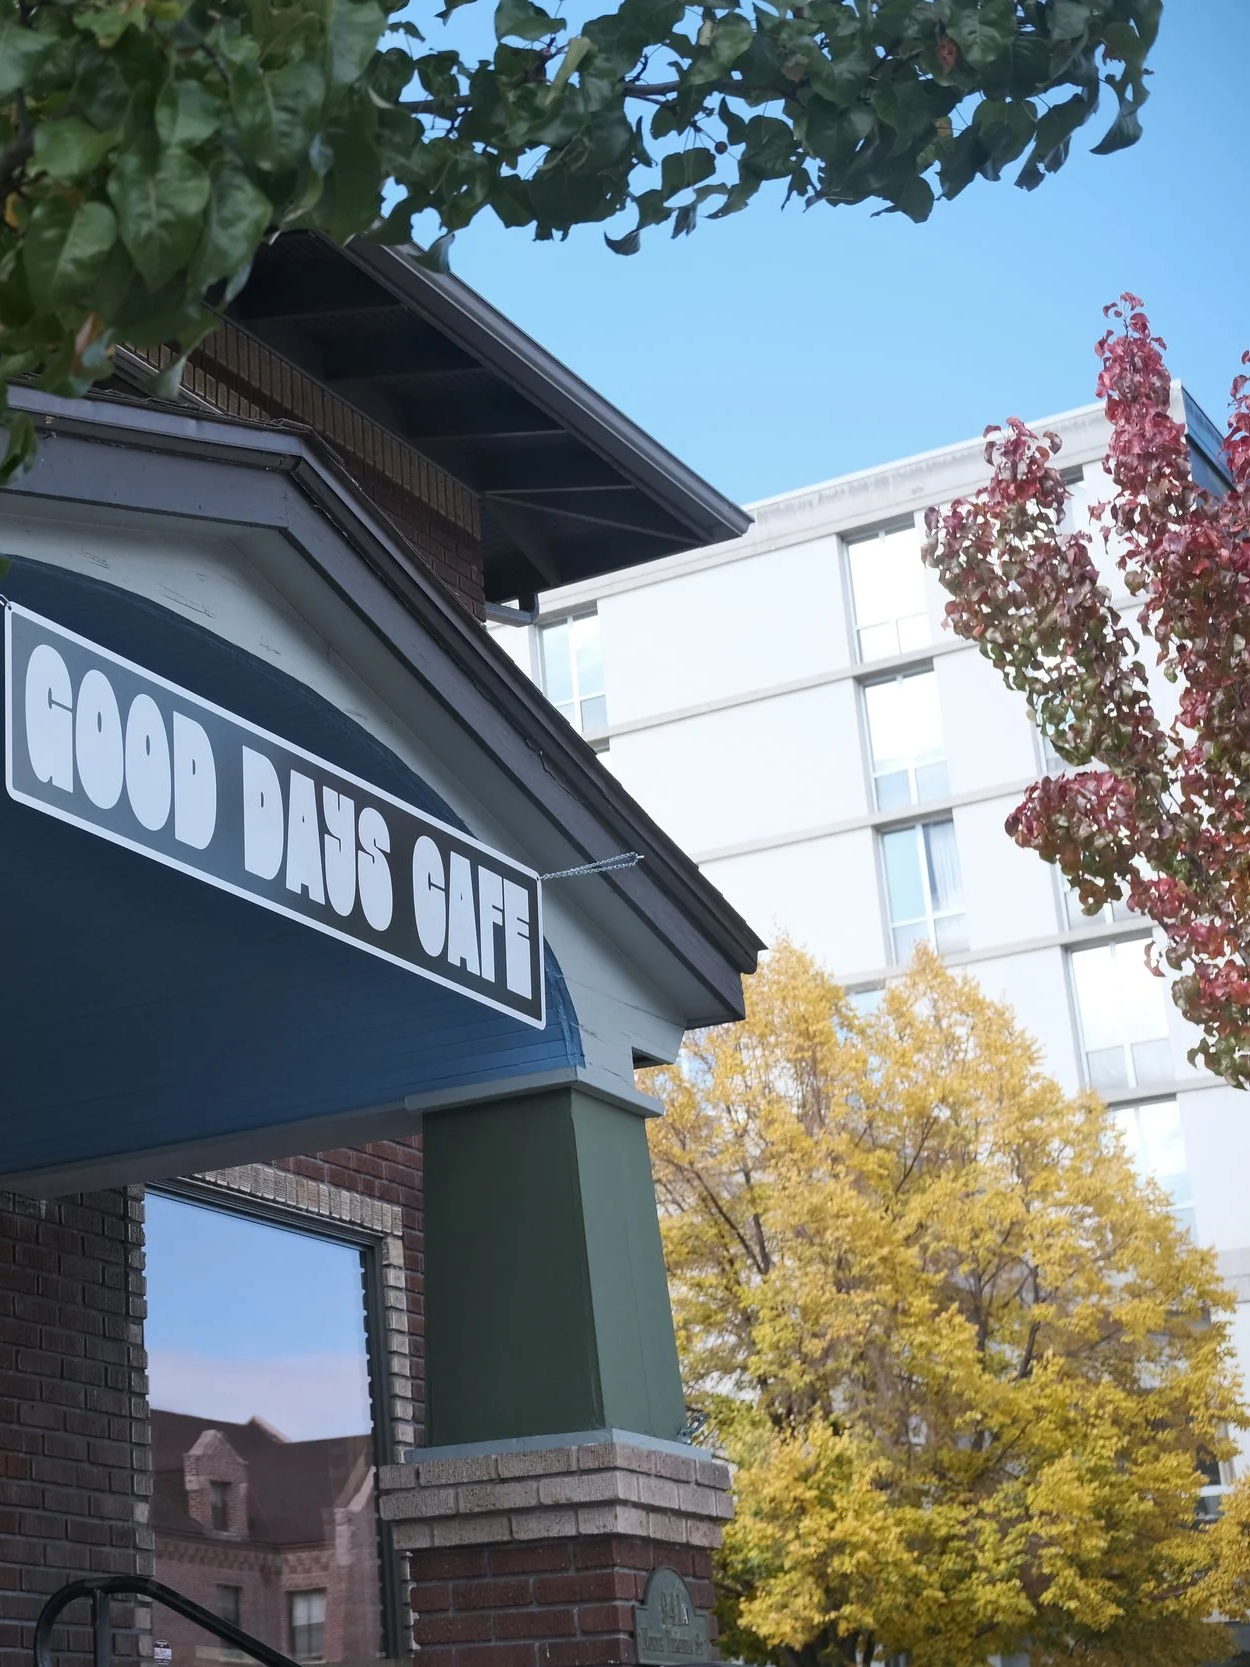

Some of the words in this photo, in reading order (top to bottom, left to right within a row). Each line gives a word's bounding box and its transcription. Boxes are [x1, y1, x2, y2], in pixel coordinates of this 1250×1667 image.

[25, 644, 217, 850] GOOD
[242, 745, 393, 932] DAYS
[412, 836, 532, 1000] CAFE
